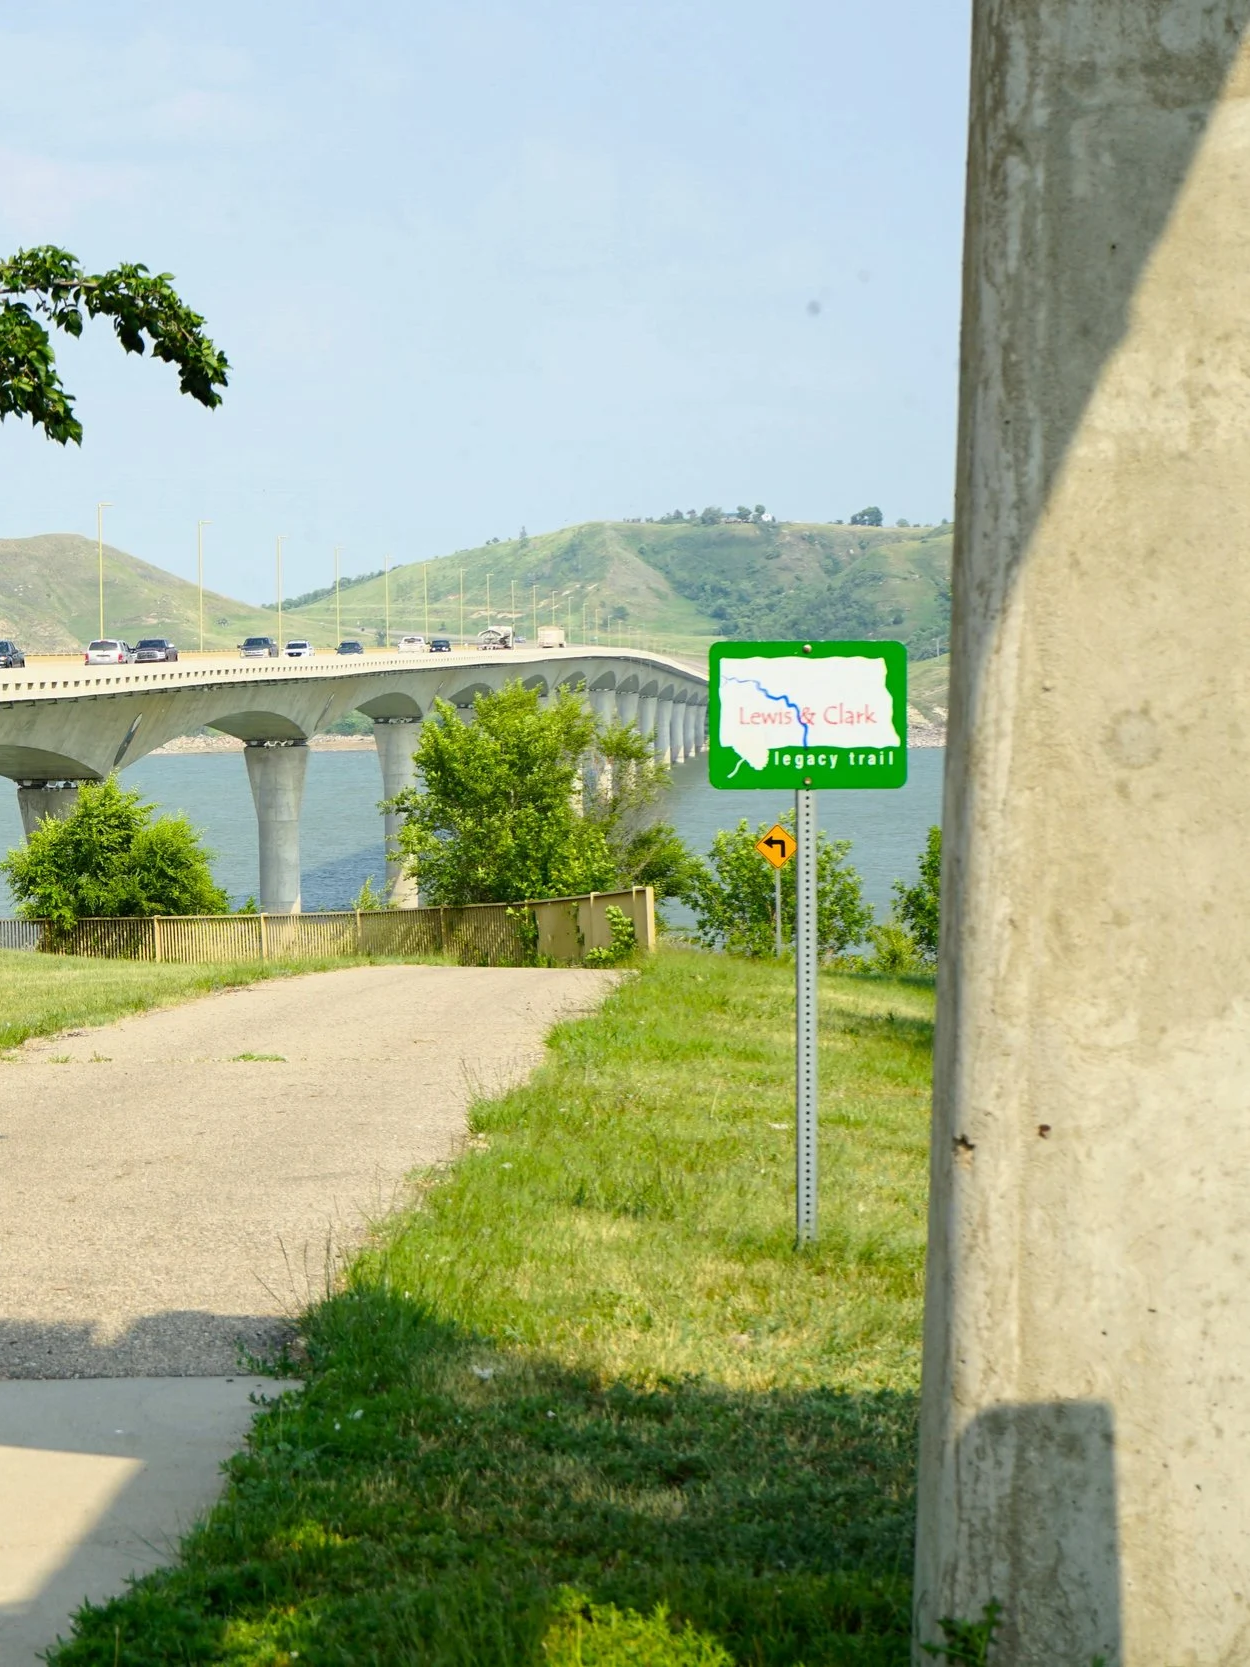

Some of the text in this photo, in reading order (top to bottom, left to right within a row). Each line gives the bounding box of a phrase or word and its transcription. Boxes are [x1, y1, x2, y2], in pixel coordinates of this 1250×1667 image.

[739, 703, 877, 726] Lewis & Clark
[774, 751, 894, 769] legacy trail
